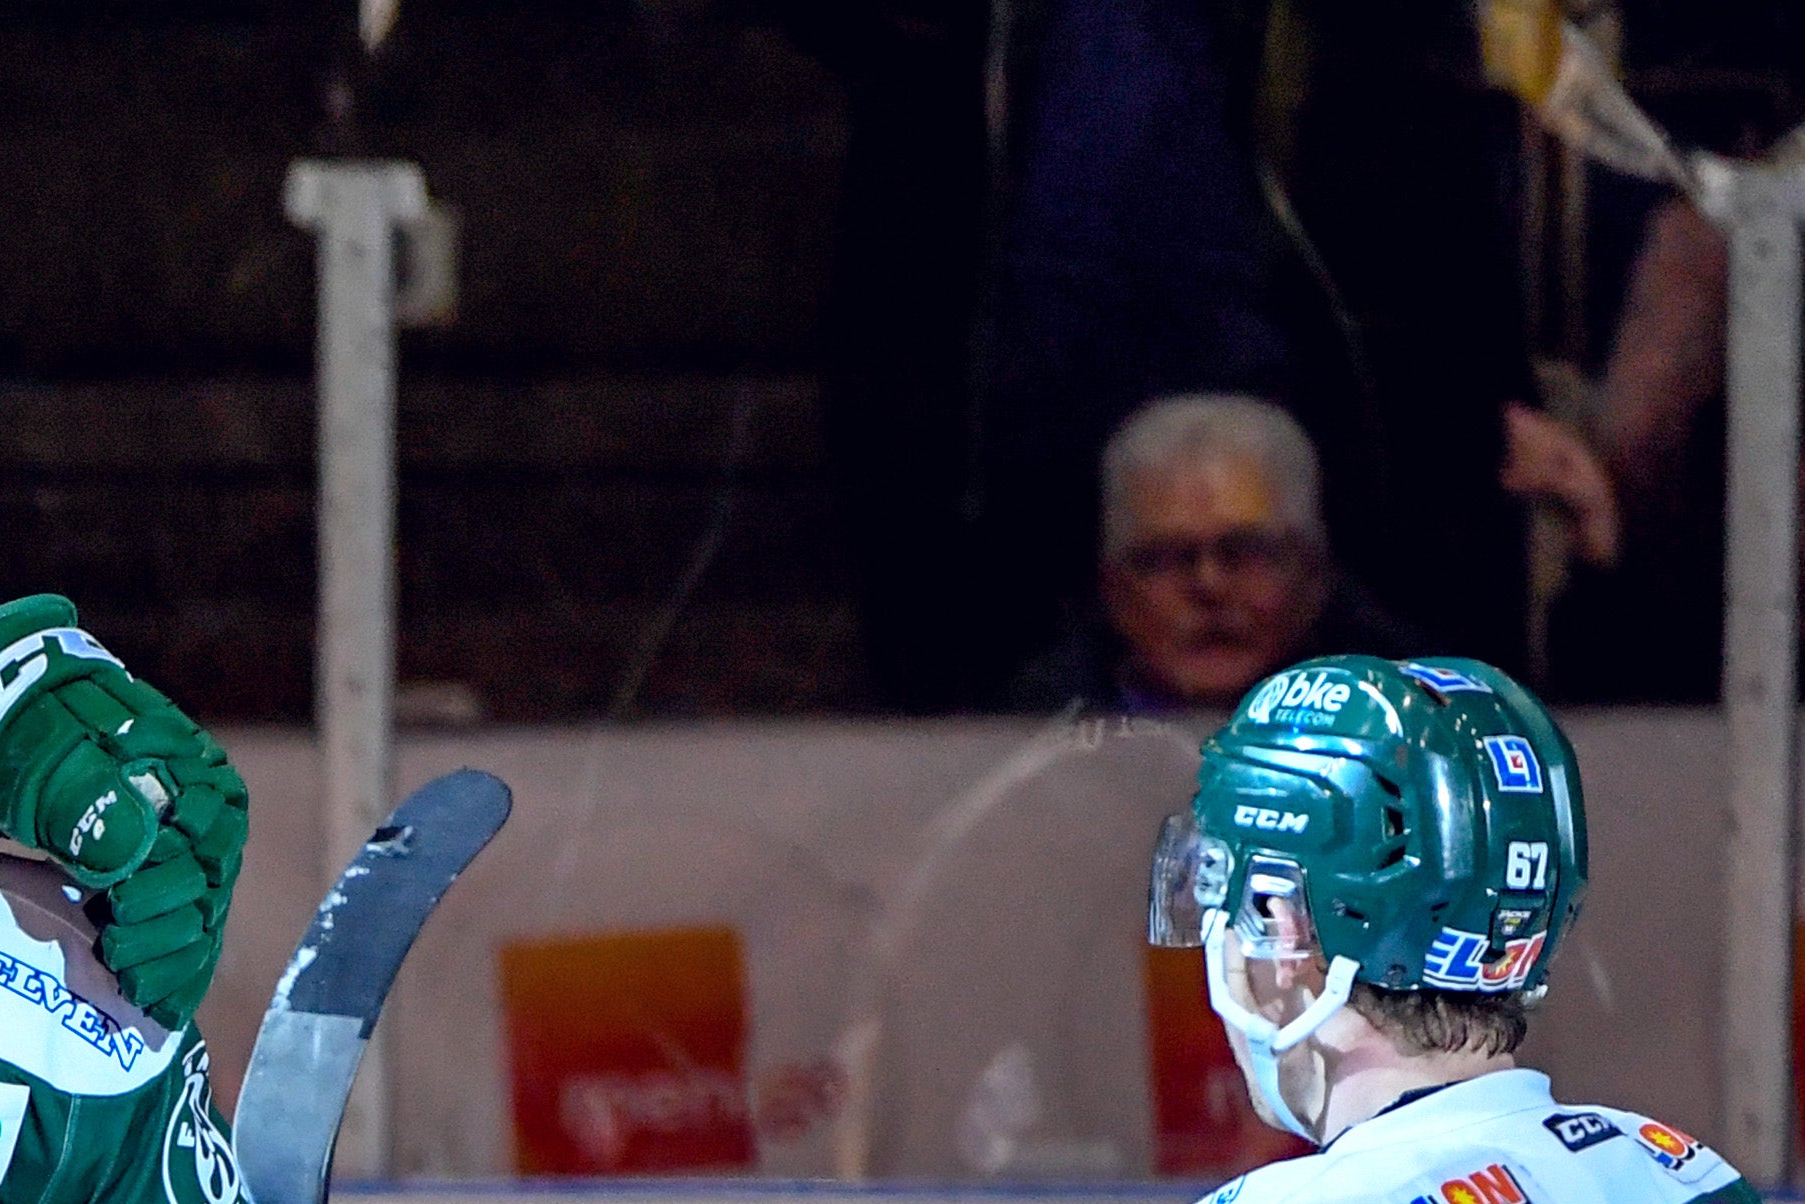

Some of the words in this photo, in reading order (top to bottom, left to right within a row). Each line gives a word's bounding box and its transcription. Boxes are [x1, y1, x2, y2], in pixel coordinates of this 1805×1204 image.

[1281, 671, 1351, 712] bke
[1234, 804, 1310, 834] CCM
[1506, 840, 1549, 890] 67
